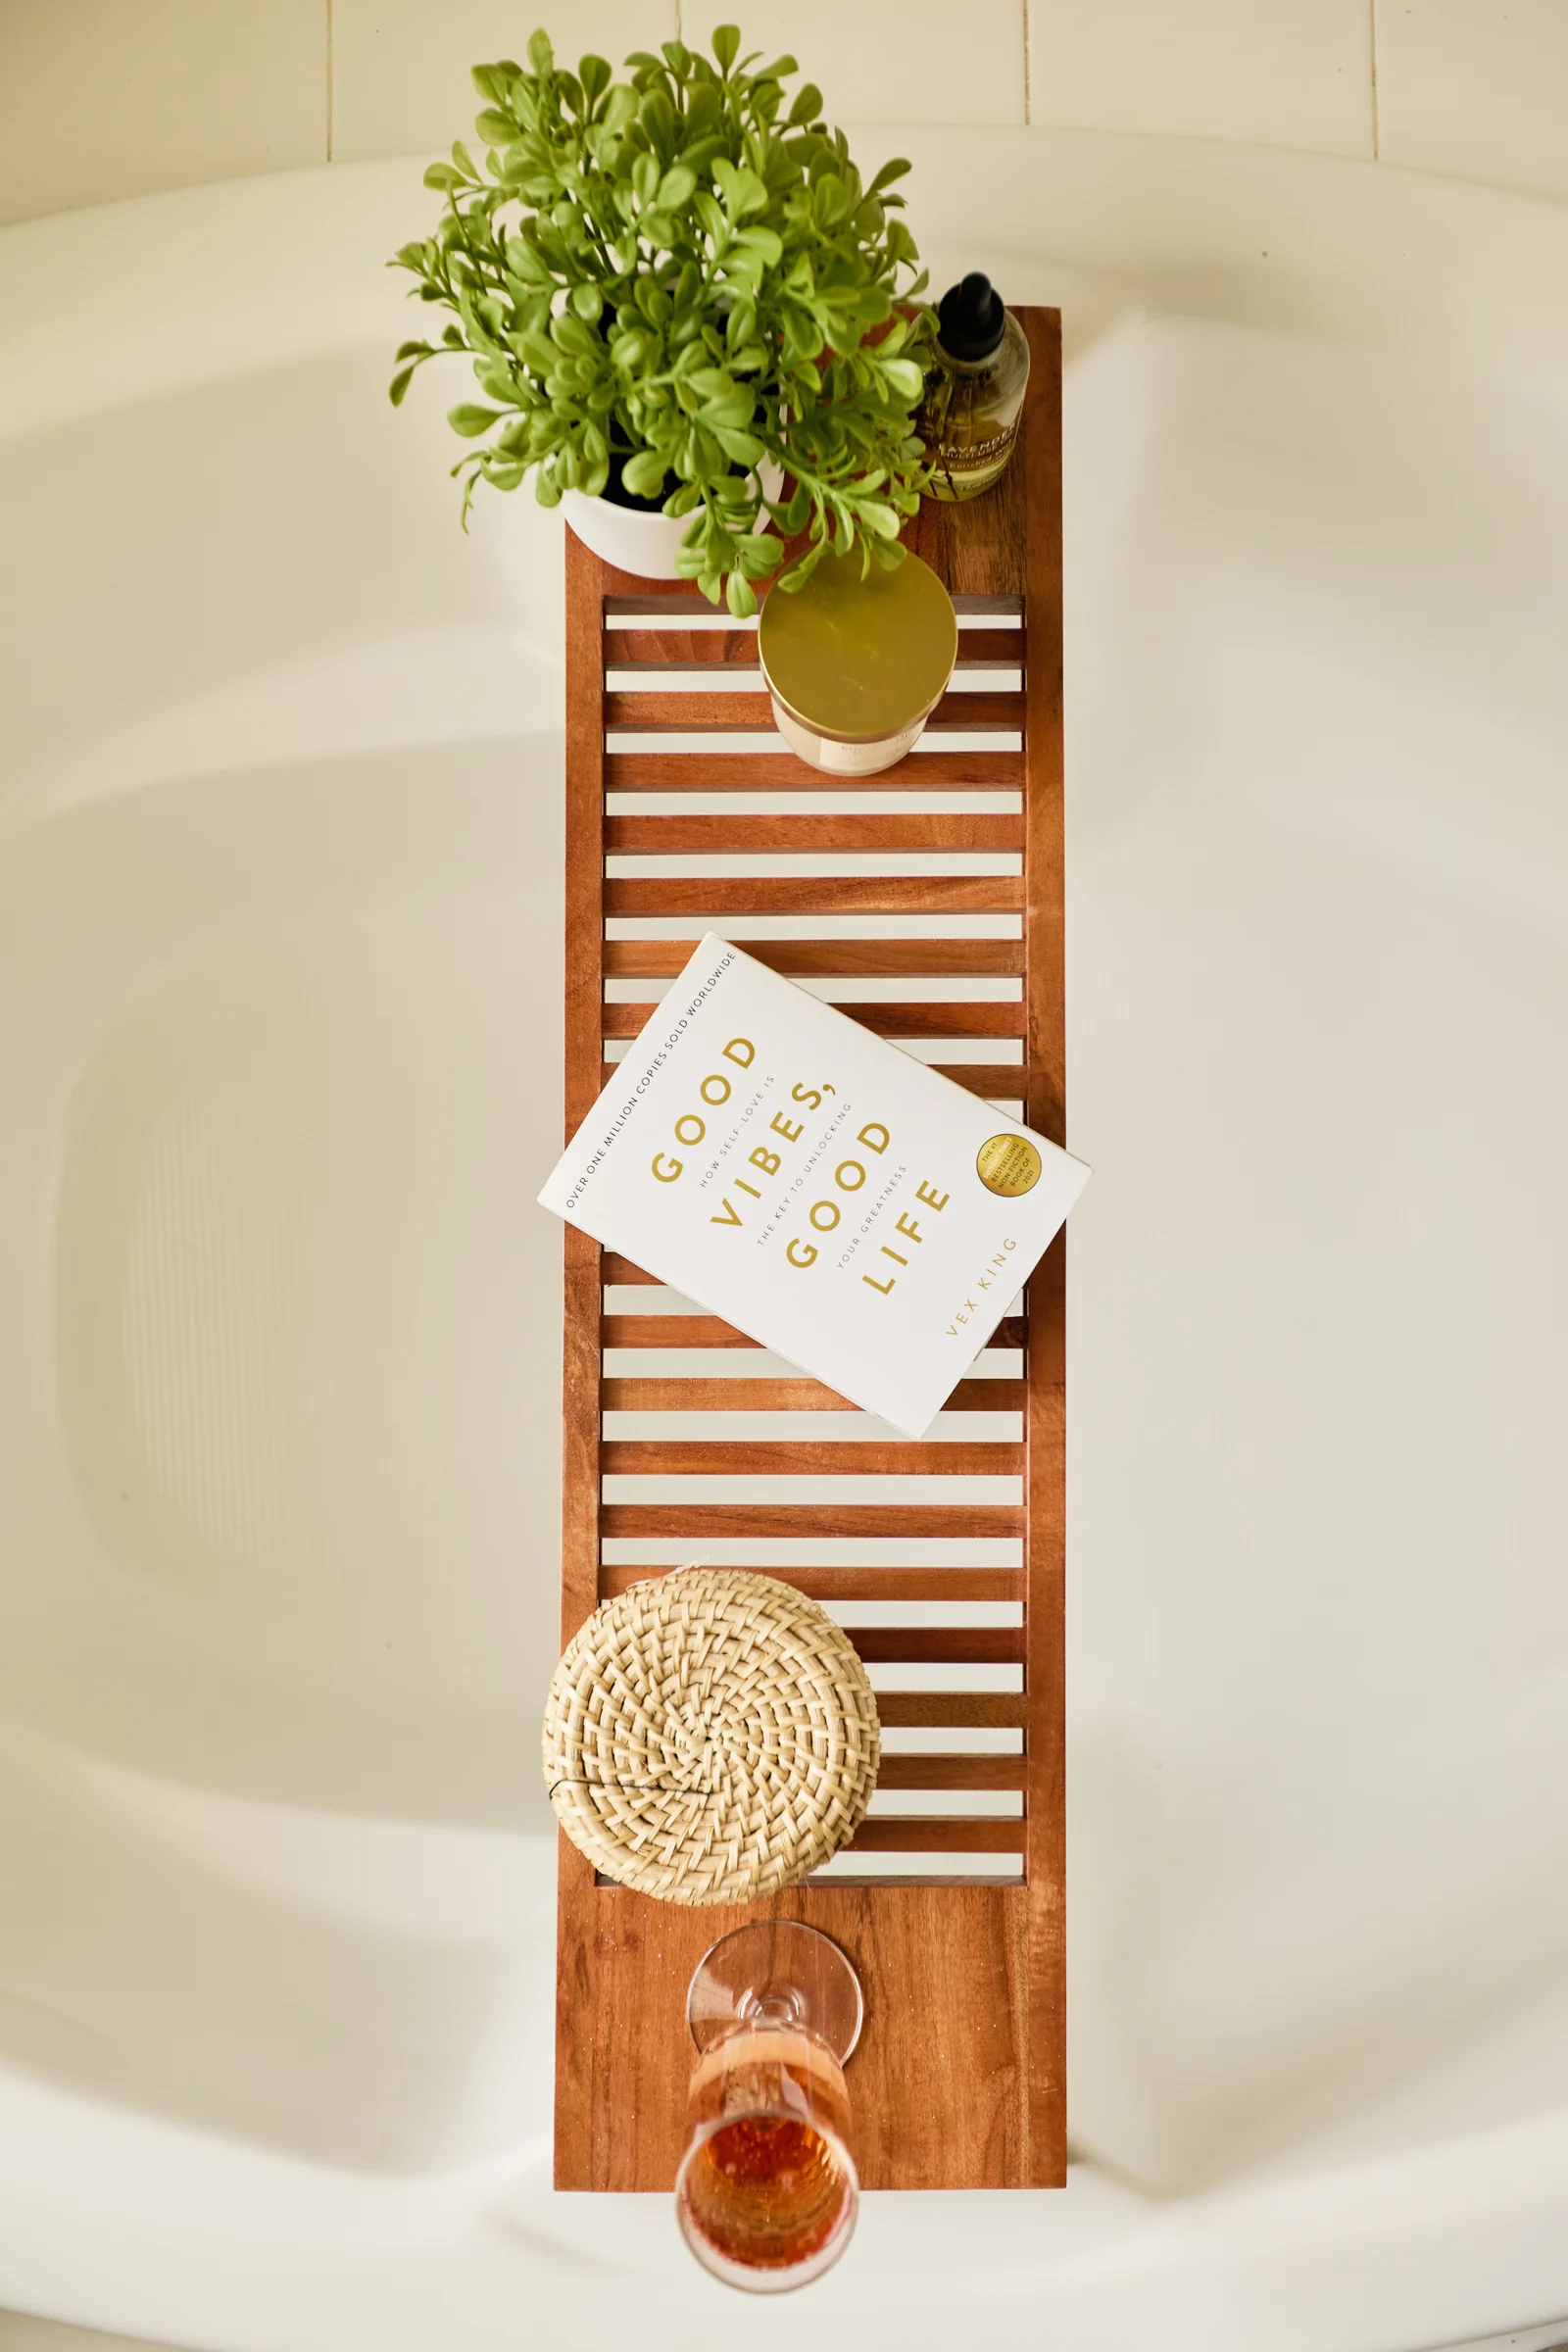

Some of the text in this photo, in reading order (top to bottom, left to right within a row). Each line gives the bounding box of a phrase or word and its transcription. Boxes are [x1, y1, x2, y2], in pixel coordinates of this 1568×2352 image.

[565, 952, 736, 1209] OVER ONE MILLION COPIES SOLD WORLDWIDE
[650, 1036, 757, 1184] GOOD
[699, 1076, 774, 1189] HOW SELF-LOVE IS
[709, 1081, 837, 1228] VIBES,
[757, 1102, 852, 1246] THE KEY TO UNLOCKING
[785, 1120, 891, 1270] GOOD
[982, 1149, 994, 1163] THE
[992, 1143, 1019, 1182] BESTSELLING
[999, 1147, 1027, 1189] NON-FICTION
[1010, 1168, 1024, 1186] BOOK
[1023, 1170, 1034, 1183] 2021
[836, 1165, 906, 1269] YOUR GREATNESS
[861, 1179, 951, 1296] LIFE
[945, 1238, 1017, 1337] VEX KING
